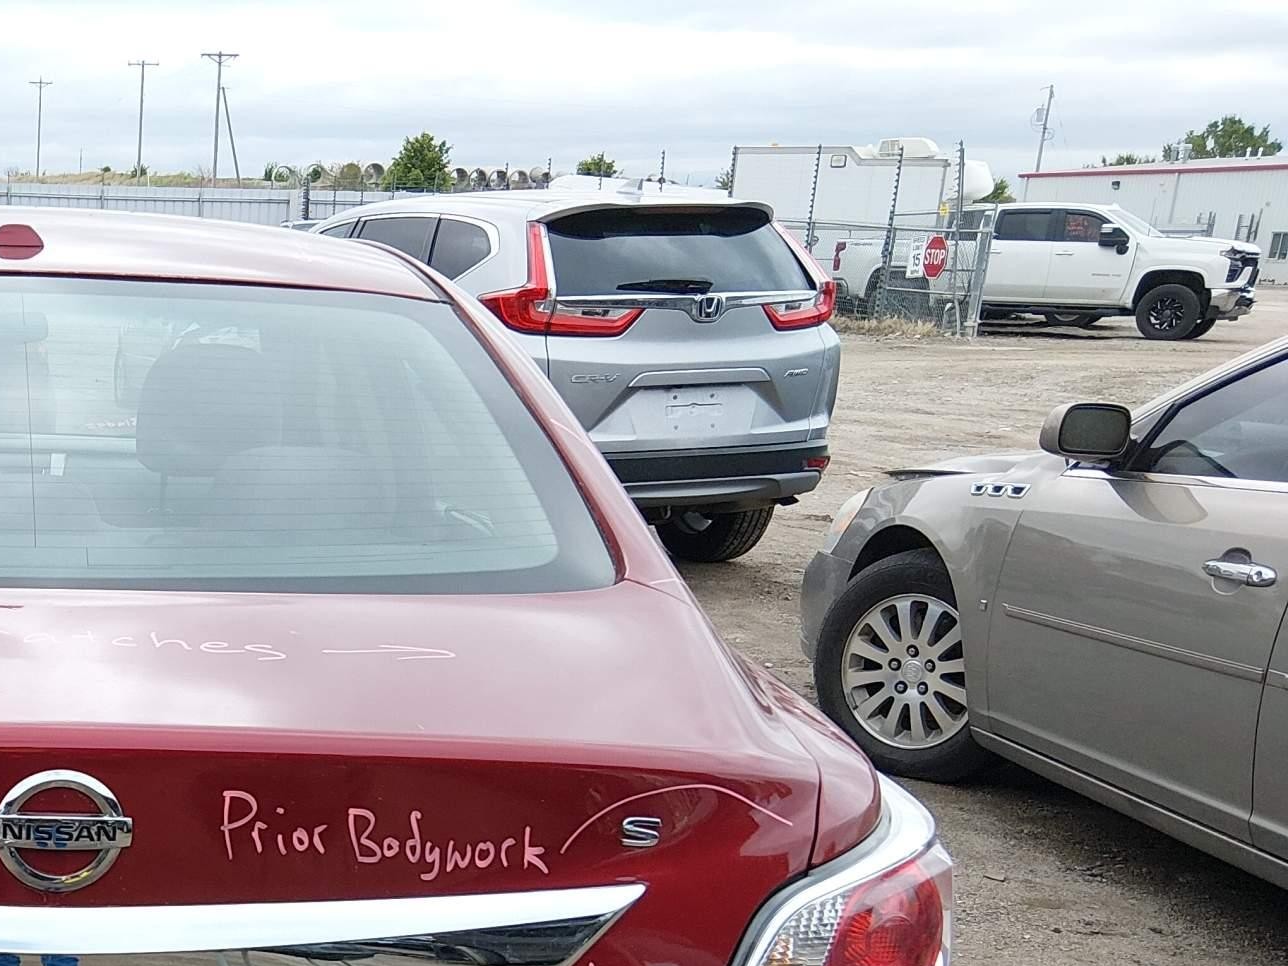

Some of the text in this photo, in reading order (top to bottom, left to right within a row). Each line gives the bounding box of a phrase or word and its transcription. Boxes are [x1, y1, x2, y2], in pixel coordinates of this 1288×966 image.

[912, 253, 921, 267] 15
[924, 249, 945, 265] STOP
[571, 372, 621, 383] CR-V
[783, 368, 808, 377] AWD
[1, 822, 118, 842] NISSAN
[220, 790, 549, 881] Prior Bodywork
[620, 816, 662, 848] S
